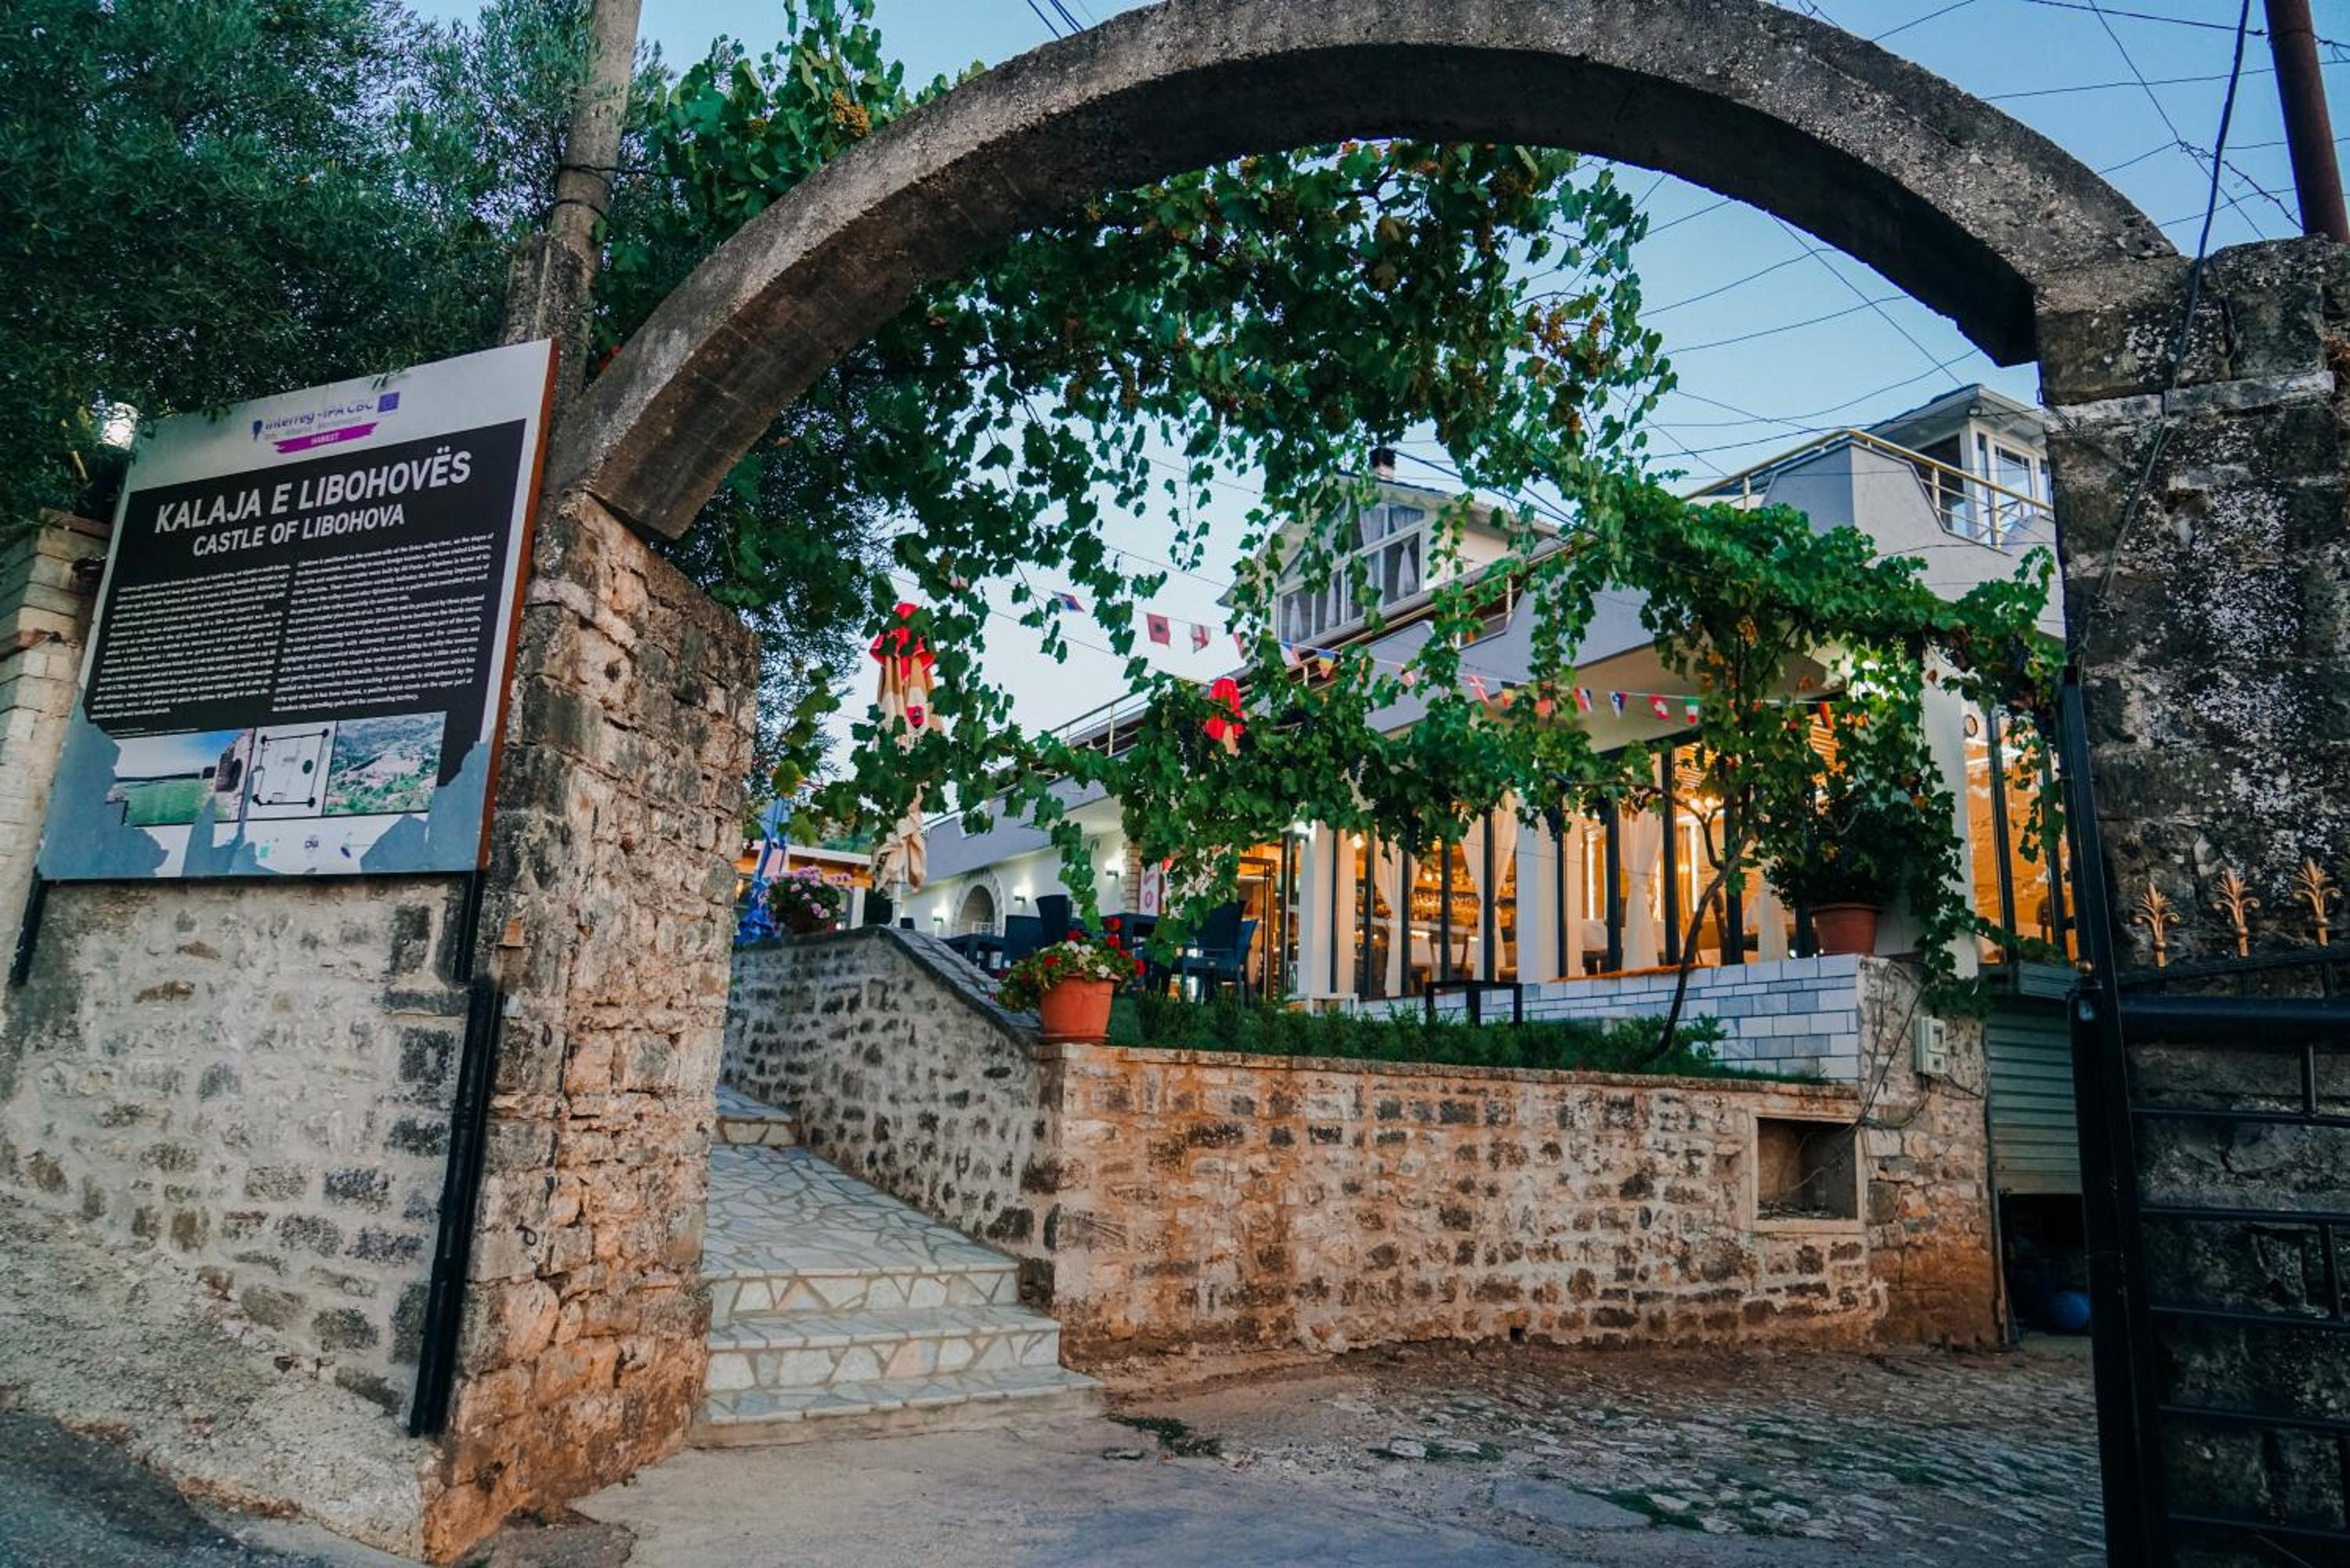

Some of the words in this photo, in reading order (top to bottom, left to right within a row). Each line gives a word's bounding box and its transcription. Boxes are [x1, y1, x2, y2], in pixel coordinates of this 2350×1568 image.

[154, 490, 261, 533] KALAJA
[271, 483, 292, 514] E
[298, 447, 472, 509] LIBOHOVËS
[193, 529, 266, 557] CASTLE
[270, 521, 298, 545] OF
[301, 504, 405, 539] LIBOHOVA
